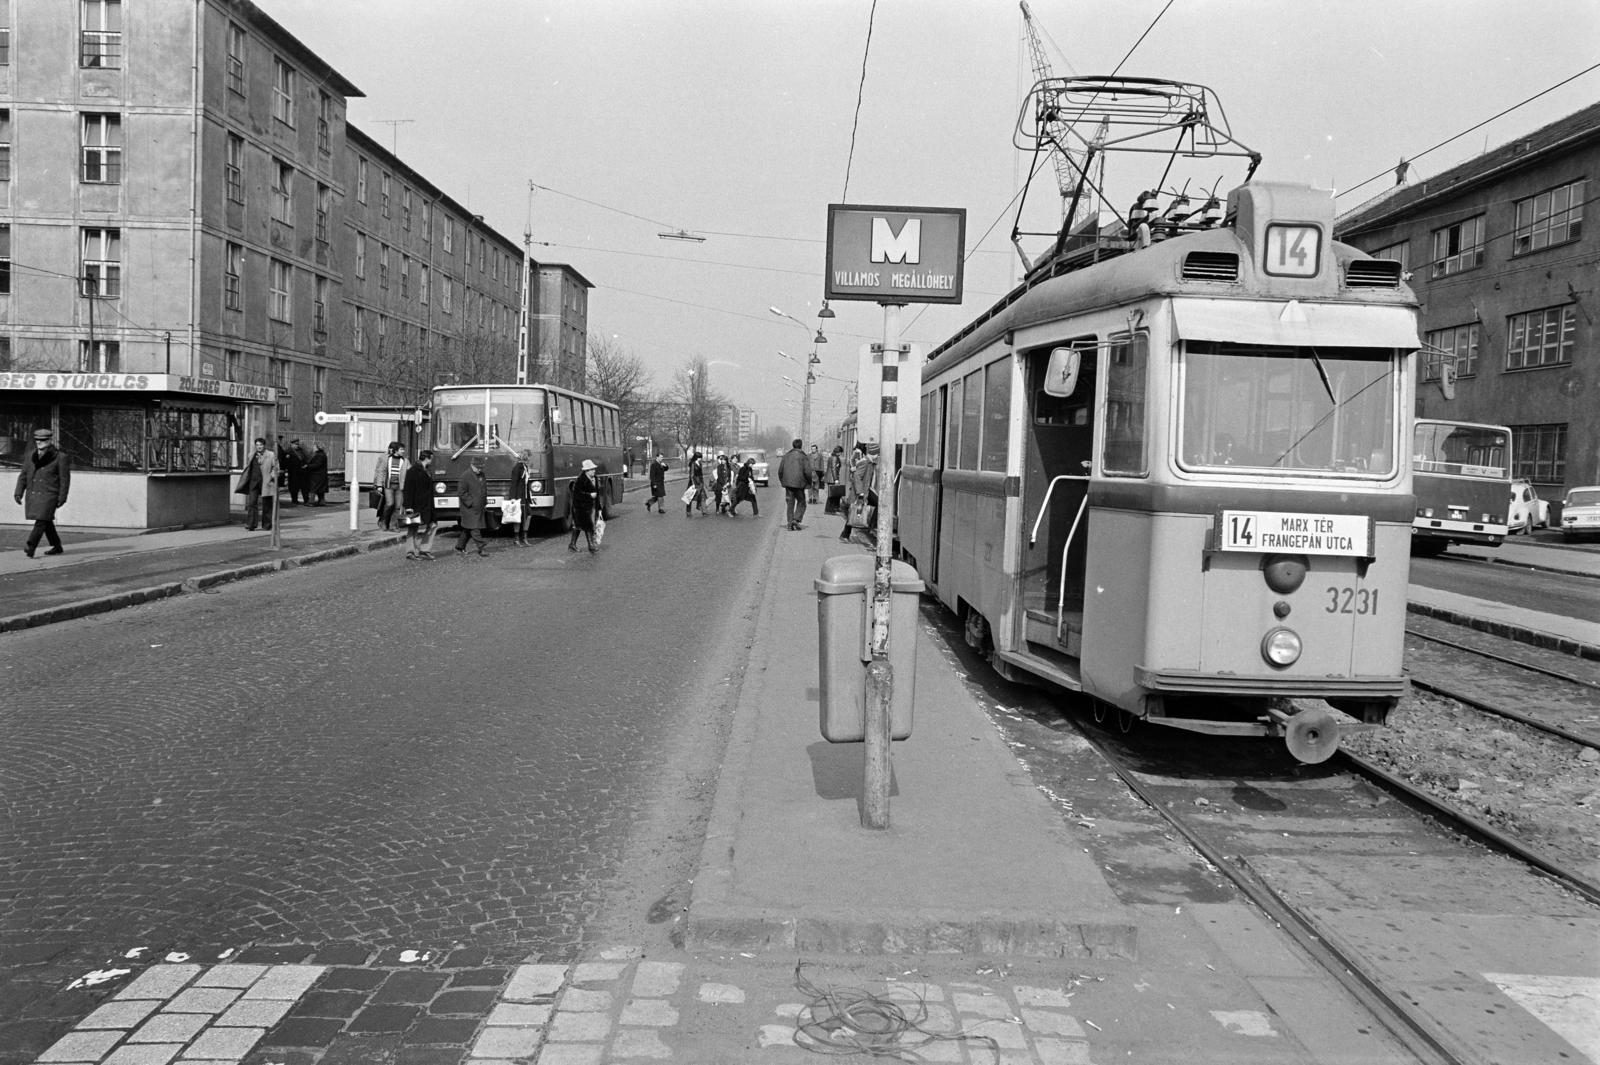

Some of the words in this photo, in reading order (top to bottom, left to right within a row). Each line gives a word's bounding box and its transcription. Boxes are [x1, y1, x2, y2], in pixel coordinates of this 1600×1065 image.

[870, 217, 921, 263] M
[1277, 227, 1307, 267] 14
[835, 271, 880, 287] VILLAMOS
[891, 269, 954, 290] MEGÁLLÓHELY
[1231, 517, 1253, 545] 14
[1281, 518, 1308, 532] MARX
[1314, 516, 1334, 533] TÉR
[1262, 533, 1322, 549] FRANGEPÁN
[1326, 536, 1353, 550] UTCA
[1325, 587, 1379, 615] 3231
